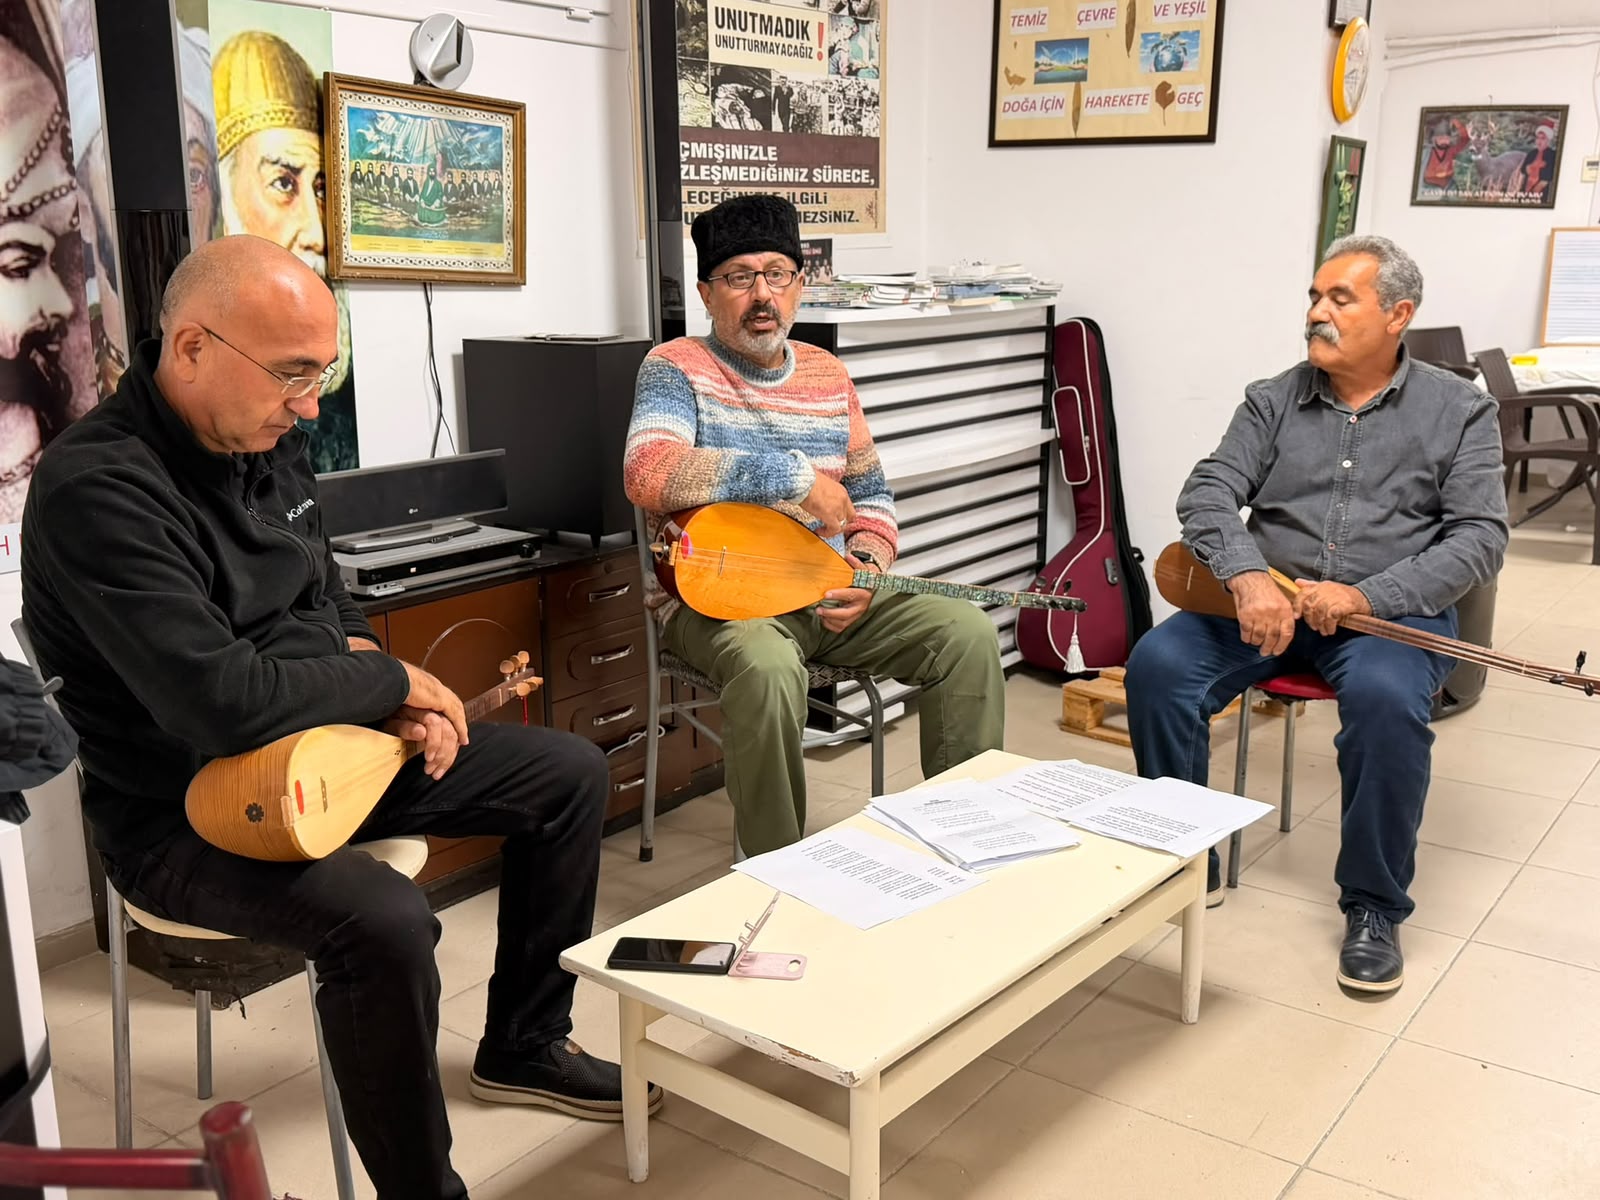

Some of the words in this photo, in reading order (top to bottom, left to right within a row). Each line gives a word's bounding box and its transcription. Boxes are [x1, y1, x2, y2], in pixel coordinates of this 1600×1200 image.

[714, 6, 811, 41] UNUTMADIK
[1010, 10, 1048, 28] TEMİZ
[1077, 7, 1116, 26] ÇEVRE
[1153, 4, 1170, 17] VE
[714, 34, 814, 60] UNUTTURMAYACAĞIZ
[1002, 97, 1037, 113] DOĞA
[1040, 95, 1064, 114] İÇİN
[1084, 93, 1149, 108] HAREKETE
[1177, 91, 1204, 107] GEÇ
[812, 165, 875, 186] SÜRECE,
